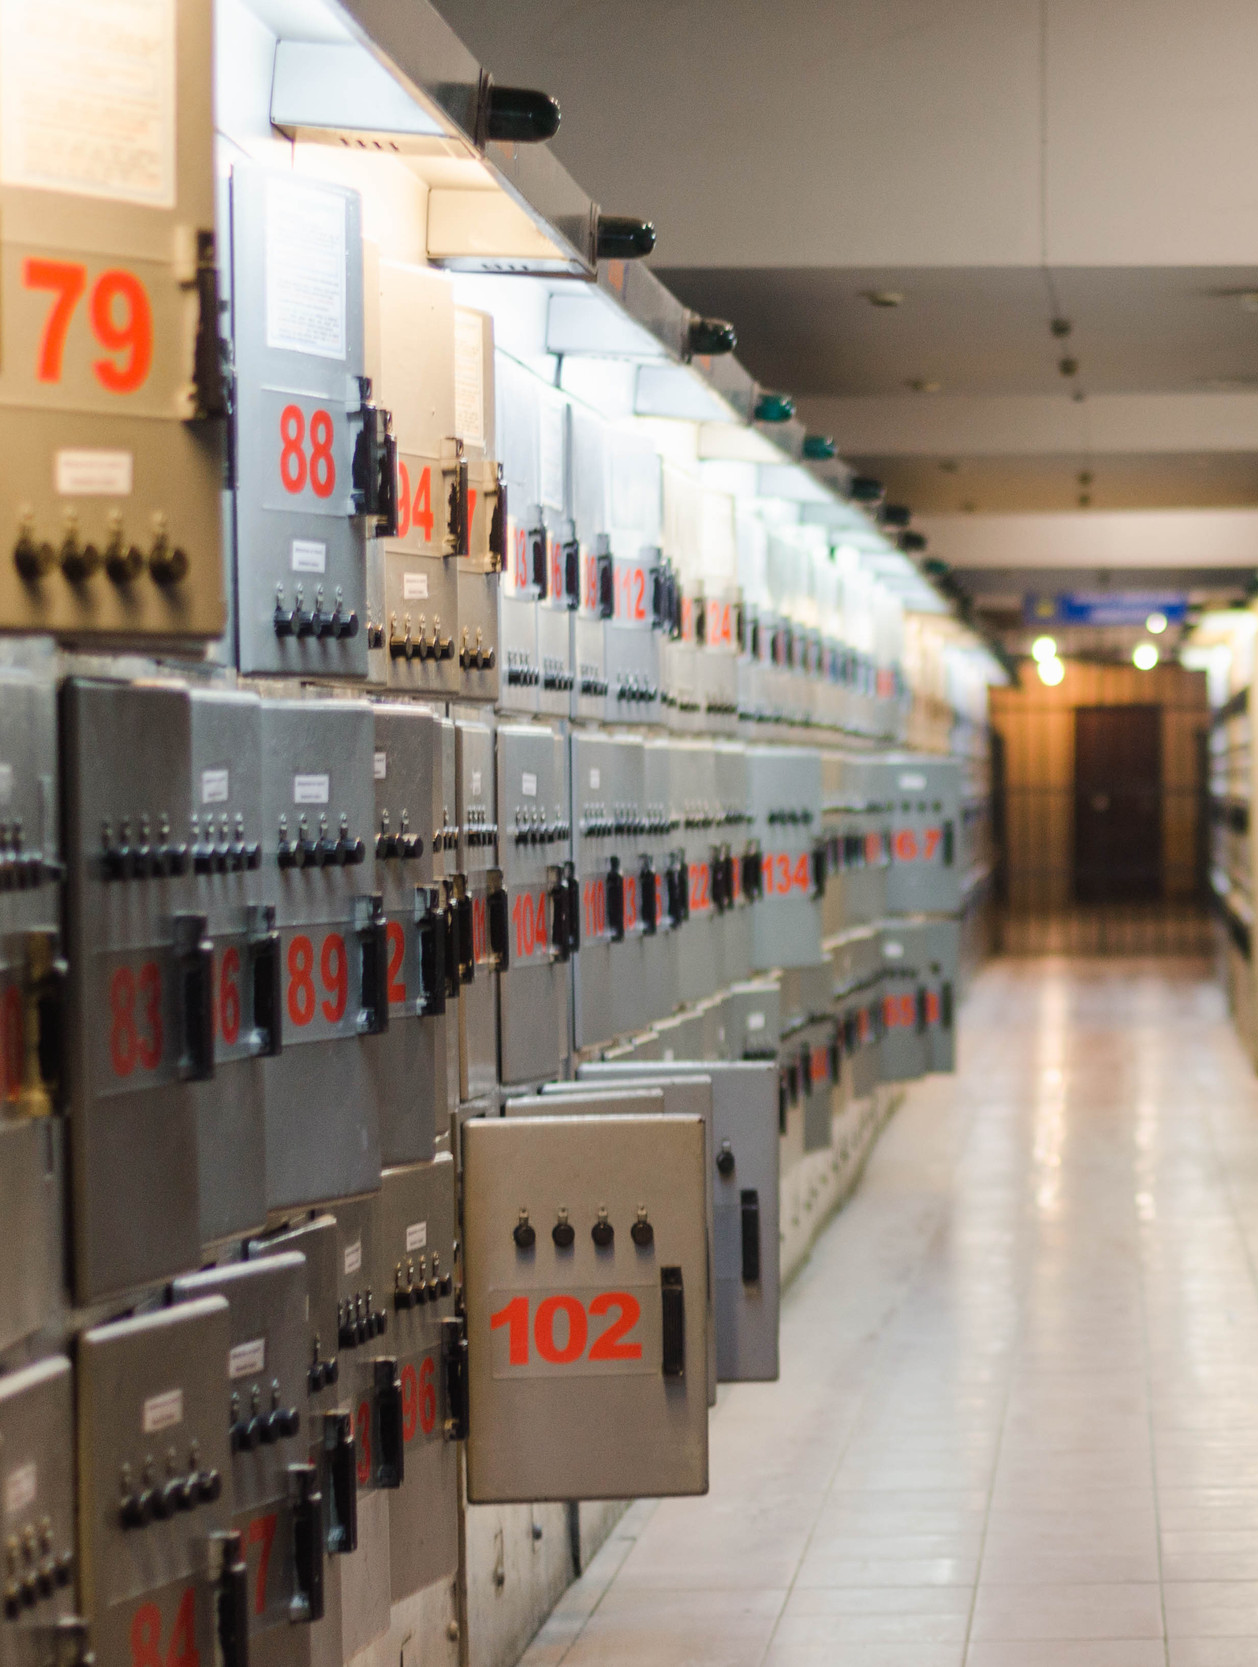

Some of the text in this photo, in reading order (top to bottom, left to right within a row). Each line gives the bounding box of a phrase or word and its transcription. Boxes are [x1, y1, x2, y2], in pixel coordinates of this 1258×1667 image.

[24, 258, 154, 396] 79
[280, 404, 336, 499] 88
[397, 460, 434, 542] 94
[762, 853, 810, 895] 134
[512, 893, 548, 957] 104
[109, 962, 163, 1078] 83
[212, 947, 240, 1046] 6
[287, 932, 348, 1027] 89
[490, 1291, 642, 1366] 102
[402, 1356, 436, 1442] 96
